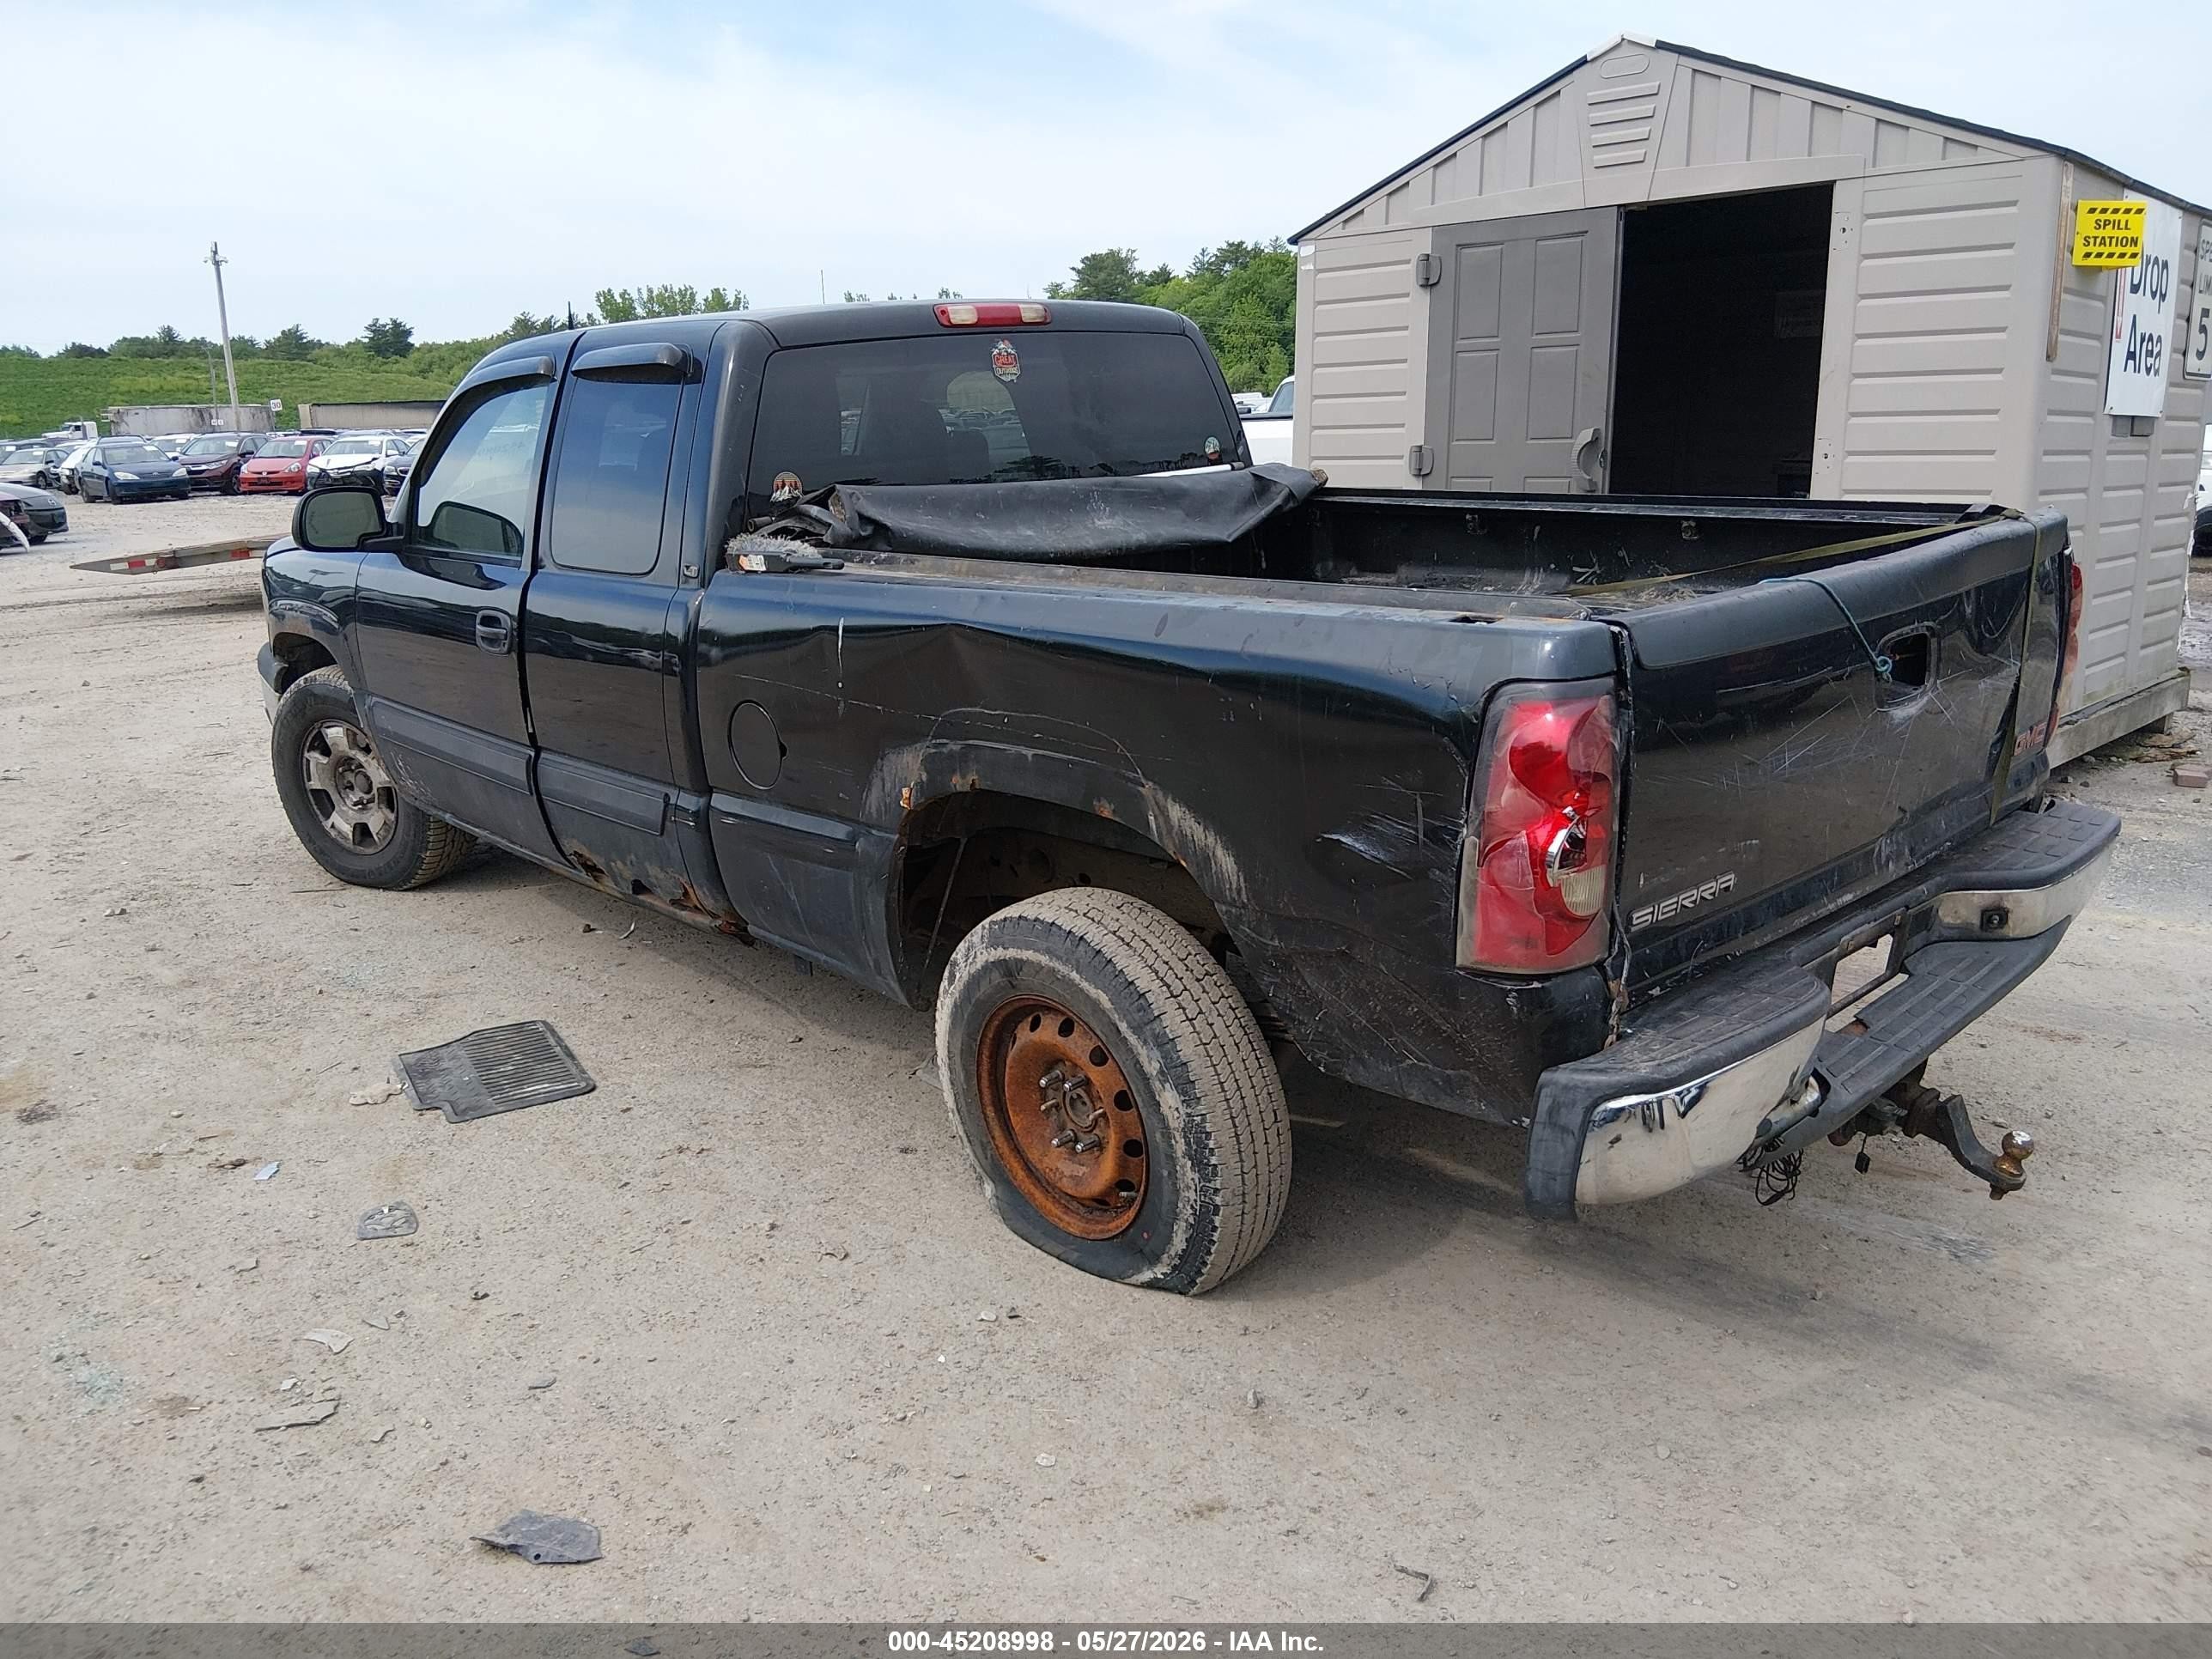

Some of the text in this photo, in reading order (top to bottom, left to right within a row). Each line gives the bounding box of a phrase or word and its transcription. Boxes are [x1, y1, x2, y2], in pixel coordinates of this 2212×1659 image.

[2082, 235, 2139, 248] STATION
[2094, 218, 2131, 231] SPILL
[2130, 240, 2169, 314] Drop
[2124, 314, 2162, 377] Area
[2196, 307, 2210, 361] 5
[1631, 871, 1736, 933] SIERRA
